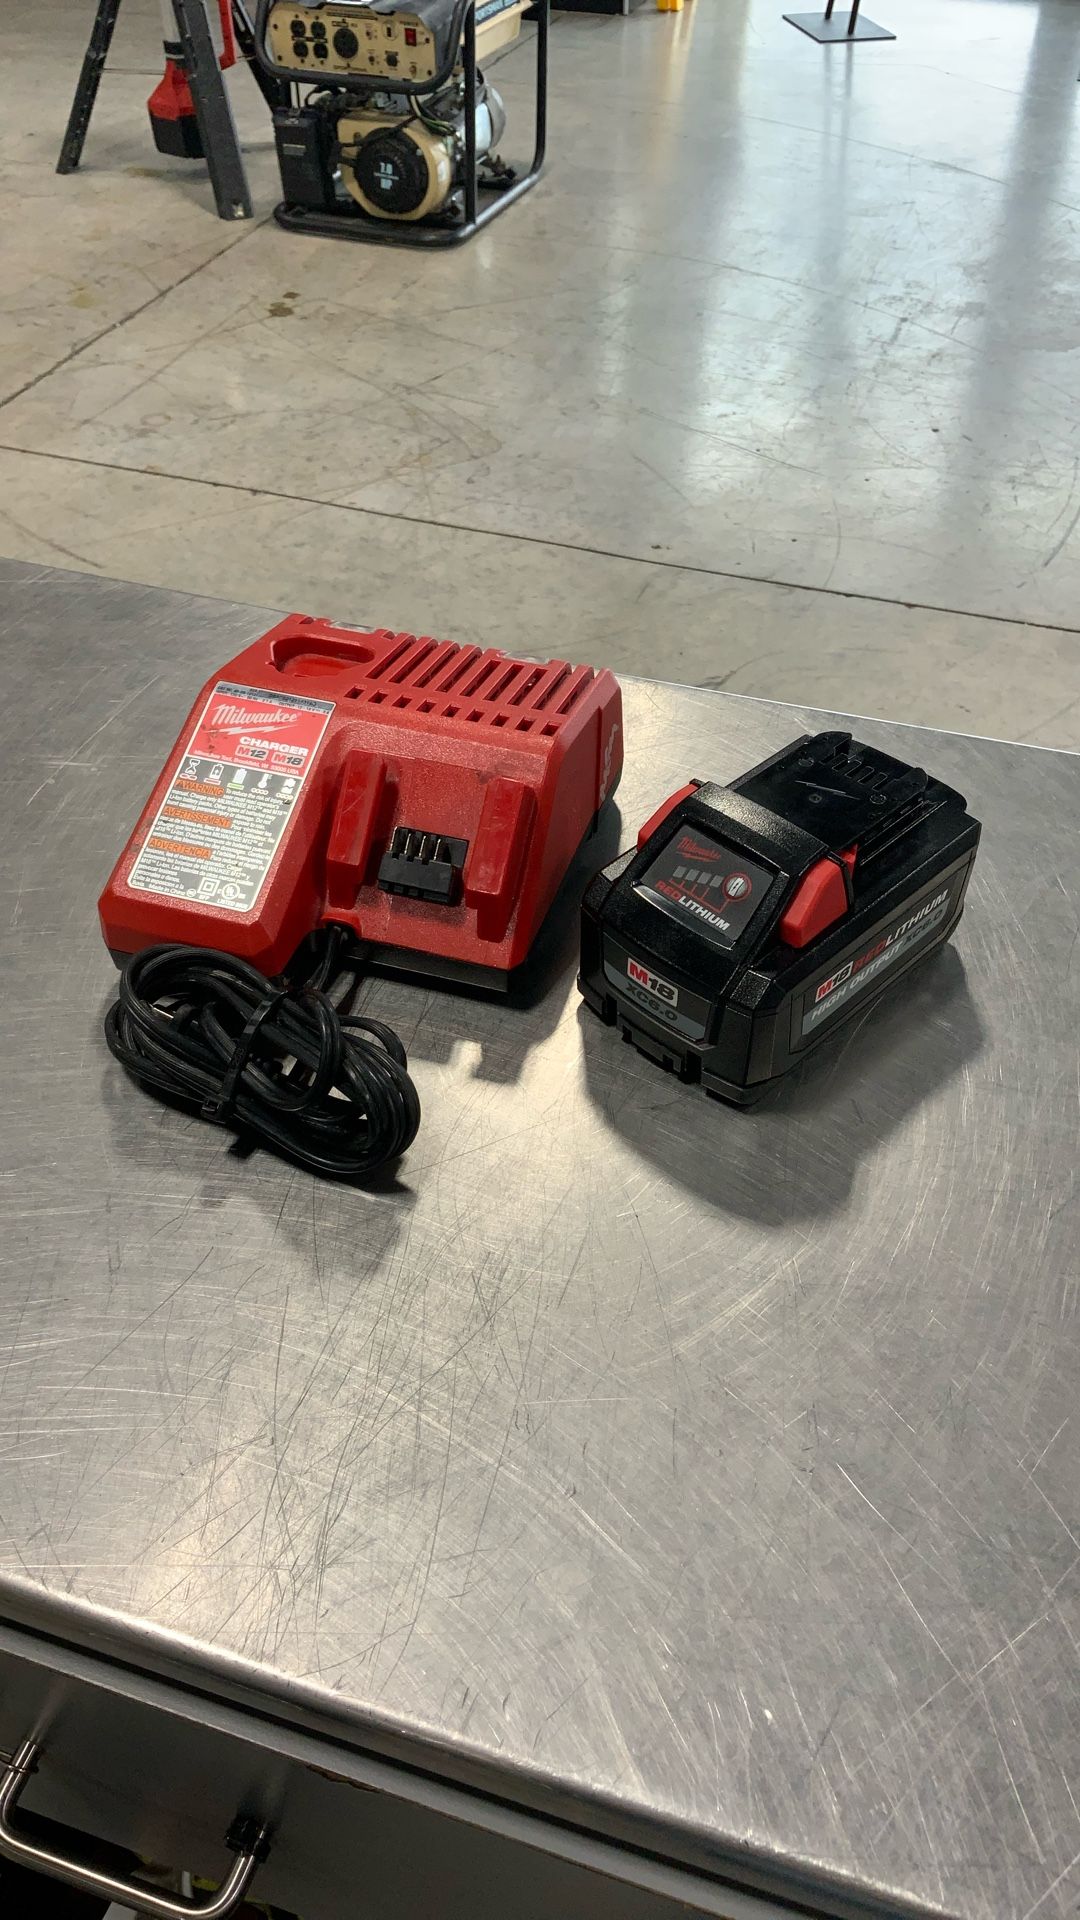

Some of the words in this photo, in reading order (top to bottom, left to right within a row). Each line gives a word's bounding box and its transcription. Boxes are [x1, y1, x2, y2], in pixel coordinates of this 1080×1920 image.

[210, 703, 298, 726] Milwaukee
[236, 746, 267, 759] M12
[273, 753, 303, 767] M18
[239, 736, 309, 757] CHARGER
[181, 781, 225, 797] WARNING
[164, 807, 230, 828] AVERTISSEMENT
[150, 838, 211, 858] ADVERTENCIA
[654, 880, 731, 931] REDLITHIUM
[818, 966, 850, 999] M18
[851, 888, 949, 976] REDLITHIUM
[629, 961, 676, 1001] M18
[811, 988, 847, 1020] HIGH
[850, 940, 904, 989] OUTPUT
[626, 982, 678, 1021] XC6.0
